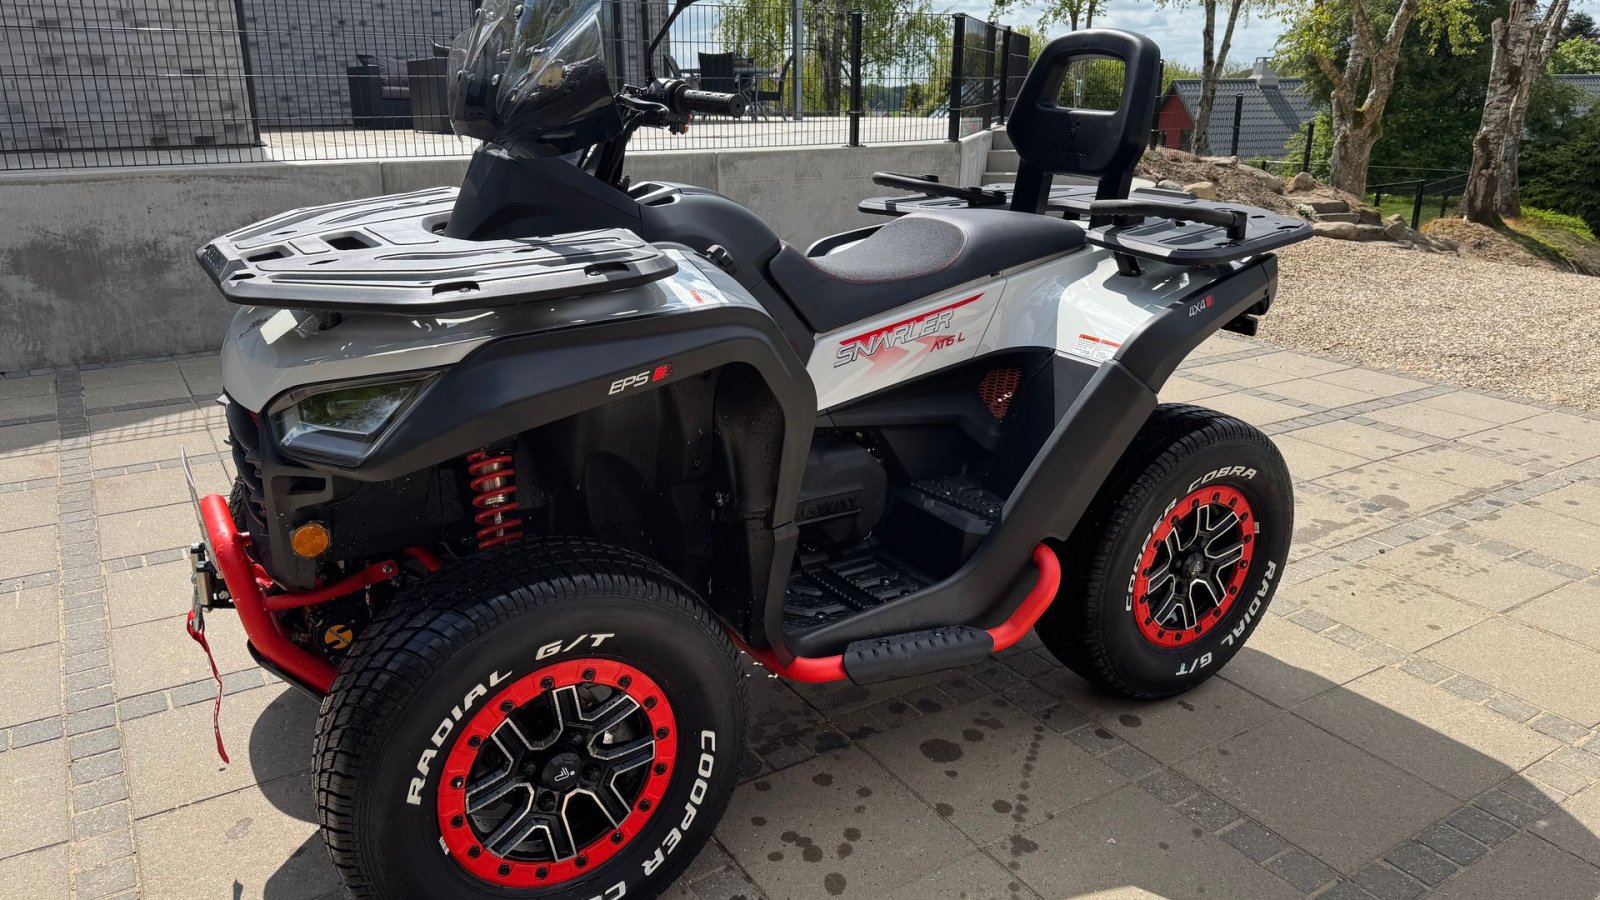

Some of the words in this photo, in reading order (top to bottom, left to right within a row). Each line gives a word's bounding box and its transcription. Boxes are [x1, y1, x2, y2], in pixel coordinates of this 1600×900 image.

[1189, 299, 1206, 317] 4X4
[833, 309, 955, 368] SNARLER
[607, 370, 651, 395] EPS
[1187, 465, 1258, 494] COBRA
[1220, 560, 1277, 646] RADIAL
[1175, 651, 1213, 676] G/T
[406, 670, 513, 805] RADIAL
[535, 633, 615, 660] G/T
[641, 730, 716, 876] COOPER
